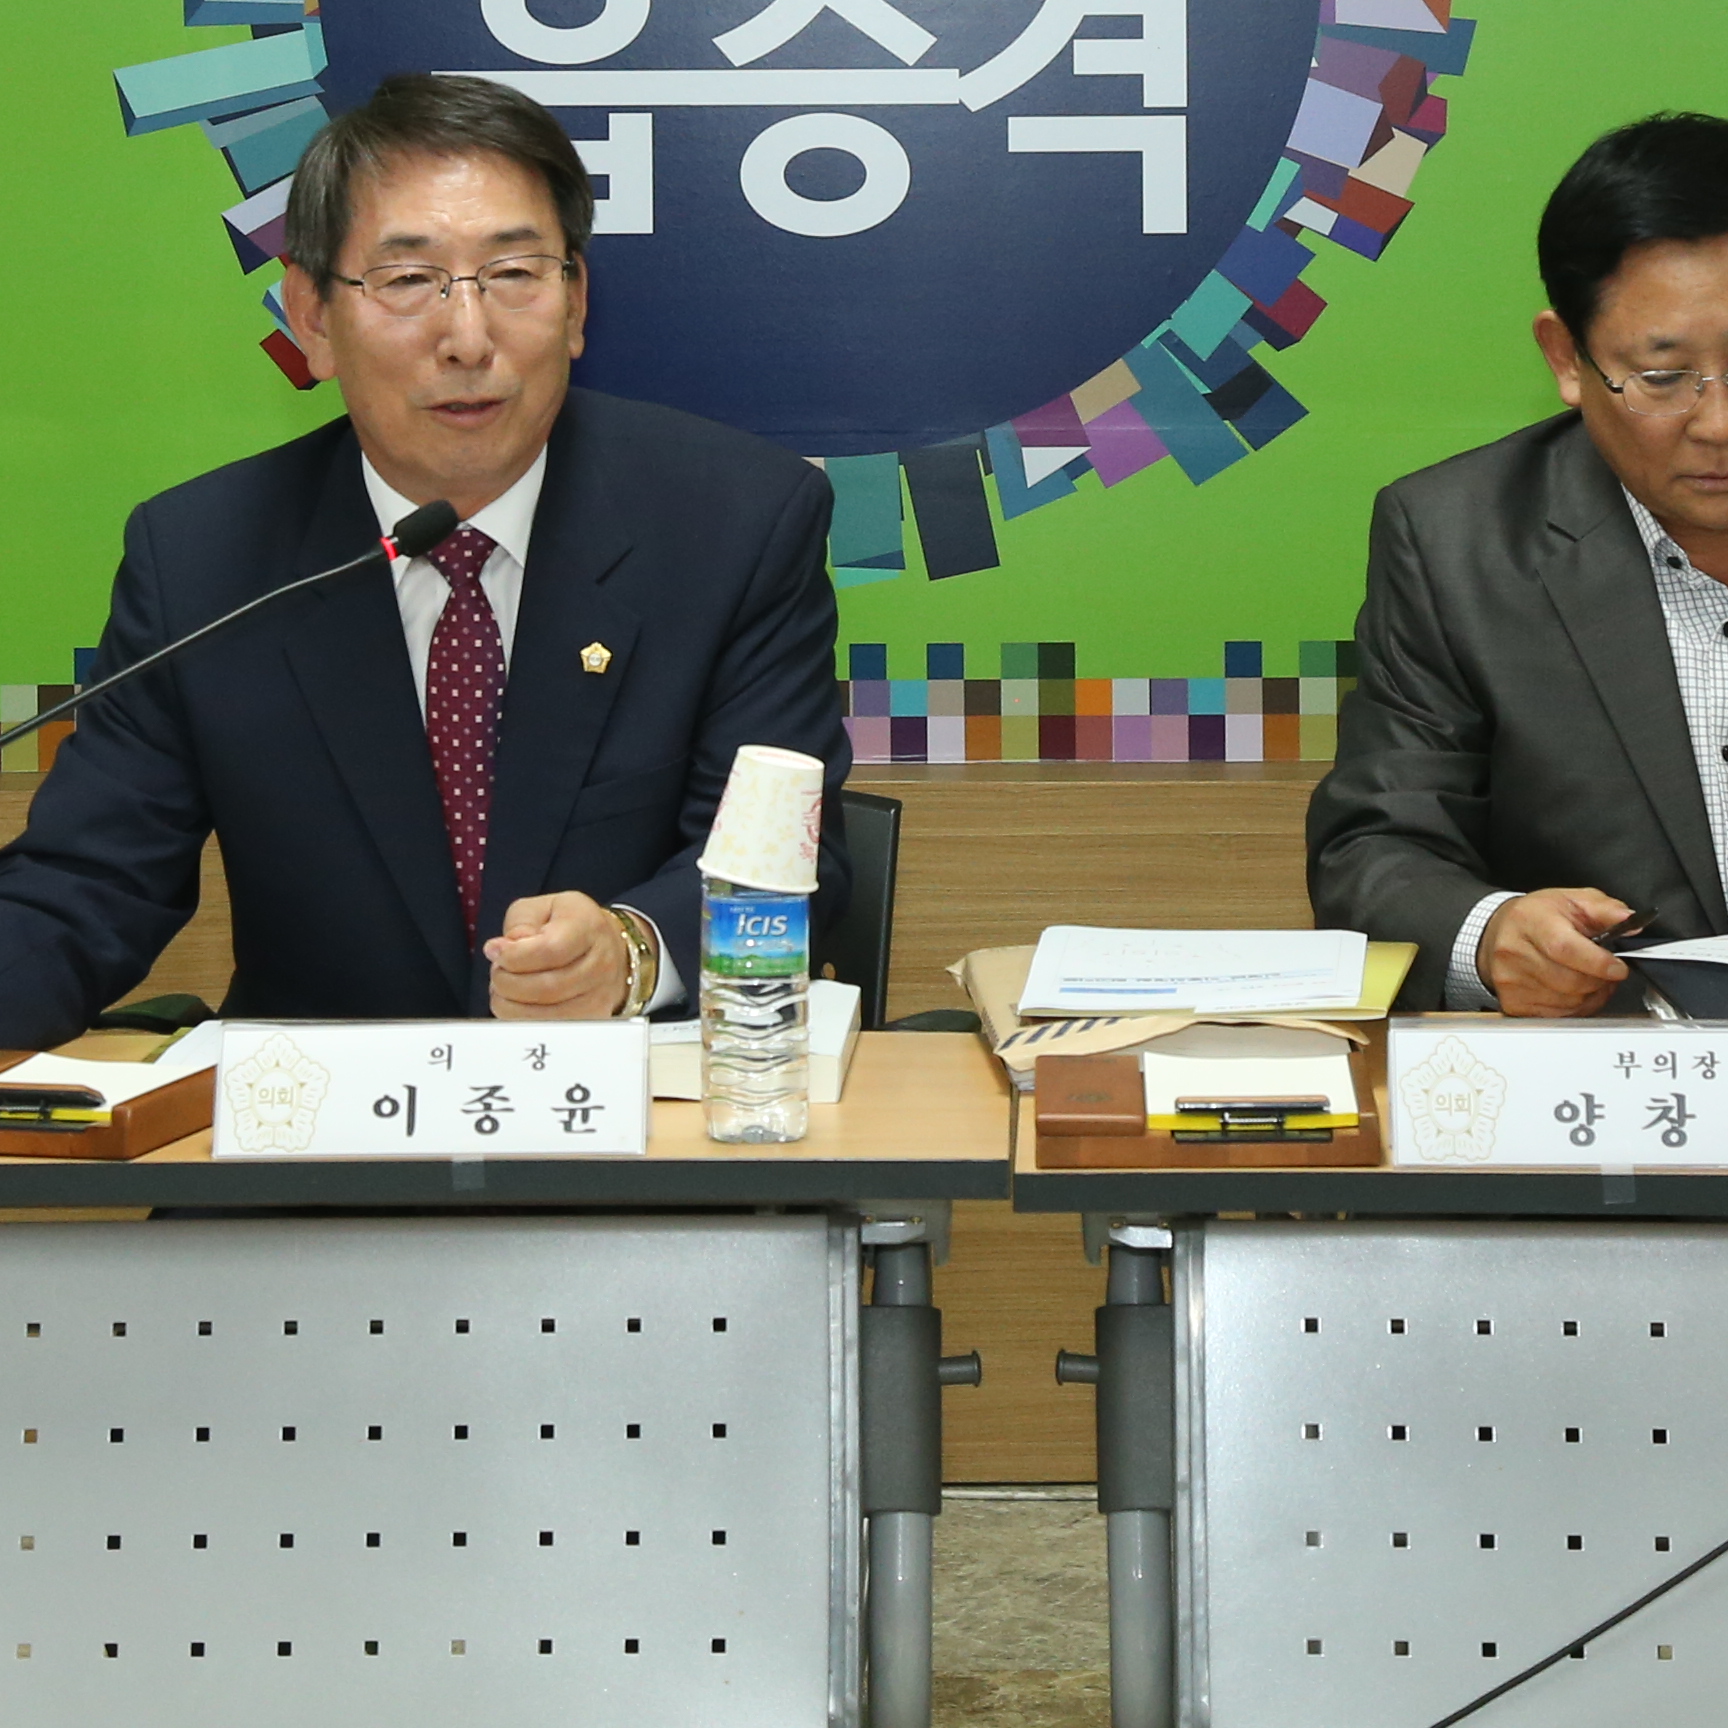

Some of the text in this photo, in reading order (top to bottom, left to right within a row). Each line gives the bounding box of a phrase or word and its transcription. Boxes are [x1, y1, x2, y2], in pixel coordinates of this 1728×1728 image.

[737, 914, 788, 937] ICIS
[1613, 1050, 1722, 1080] 부의장
[257, 1085, 295, 1109] 의회
[1434, 1092, 1473, 1118] 의회
[372, 1083, 606, 1138] 이종윤
